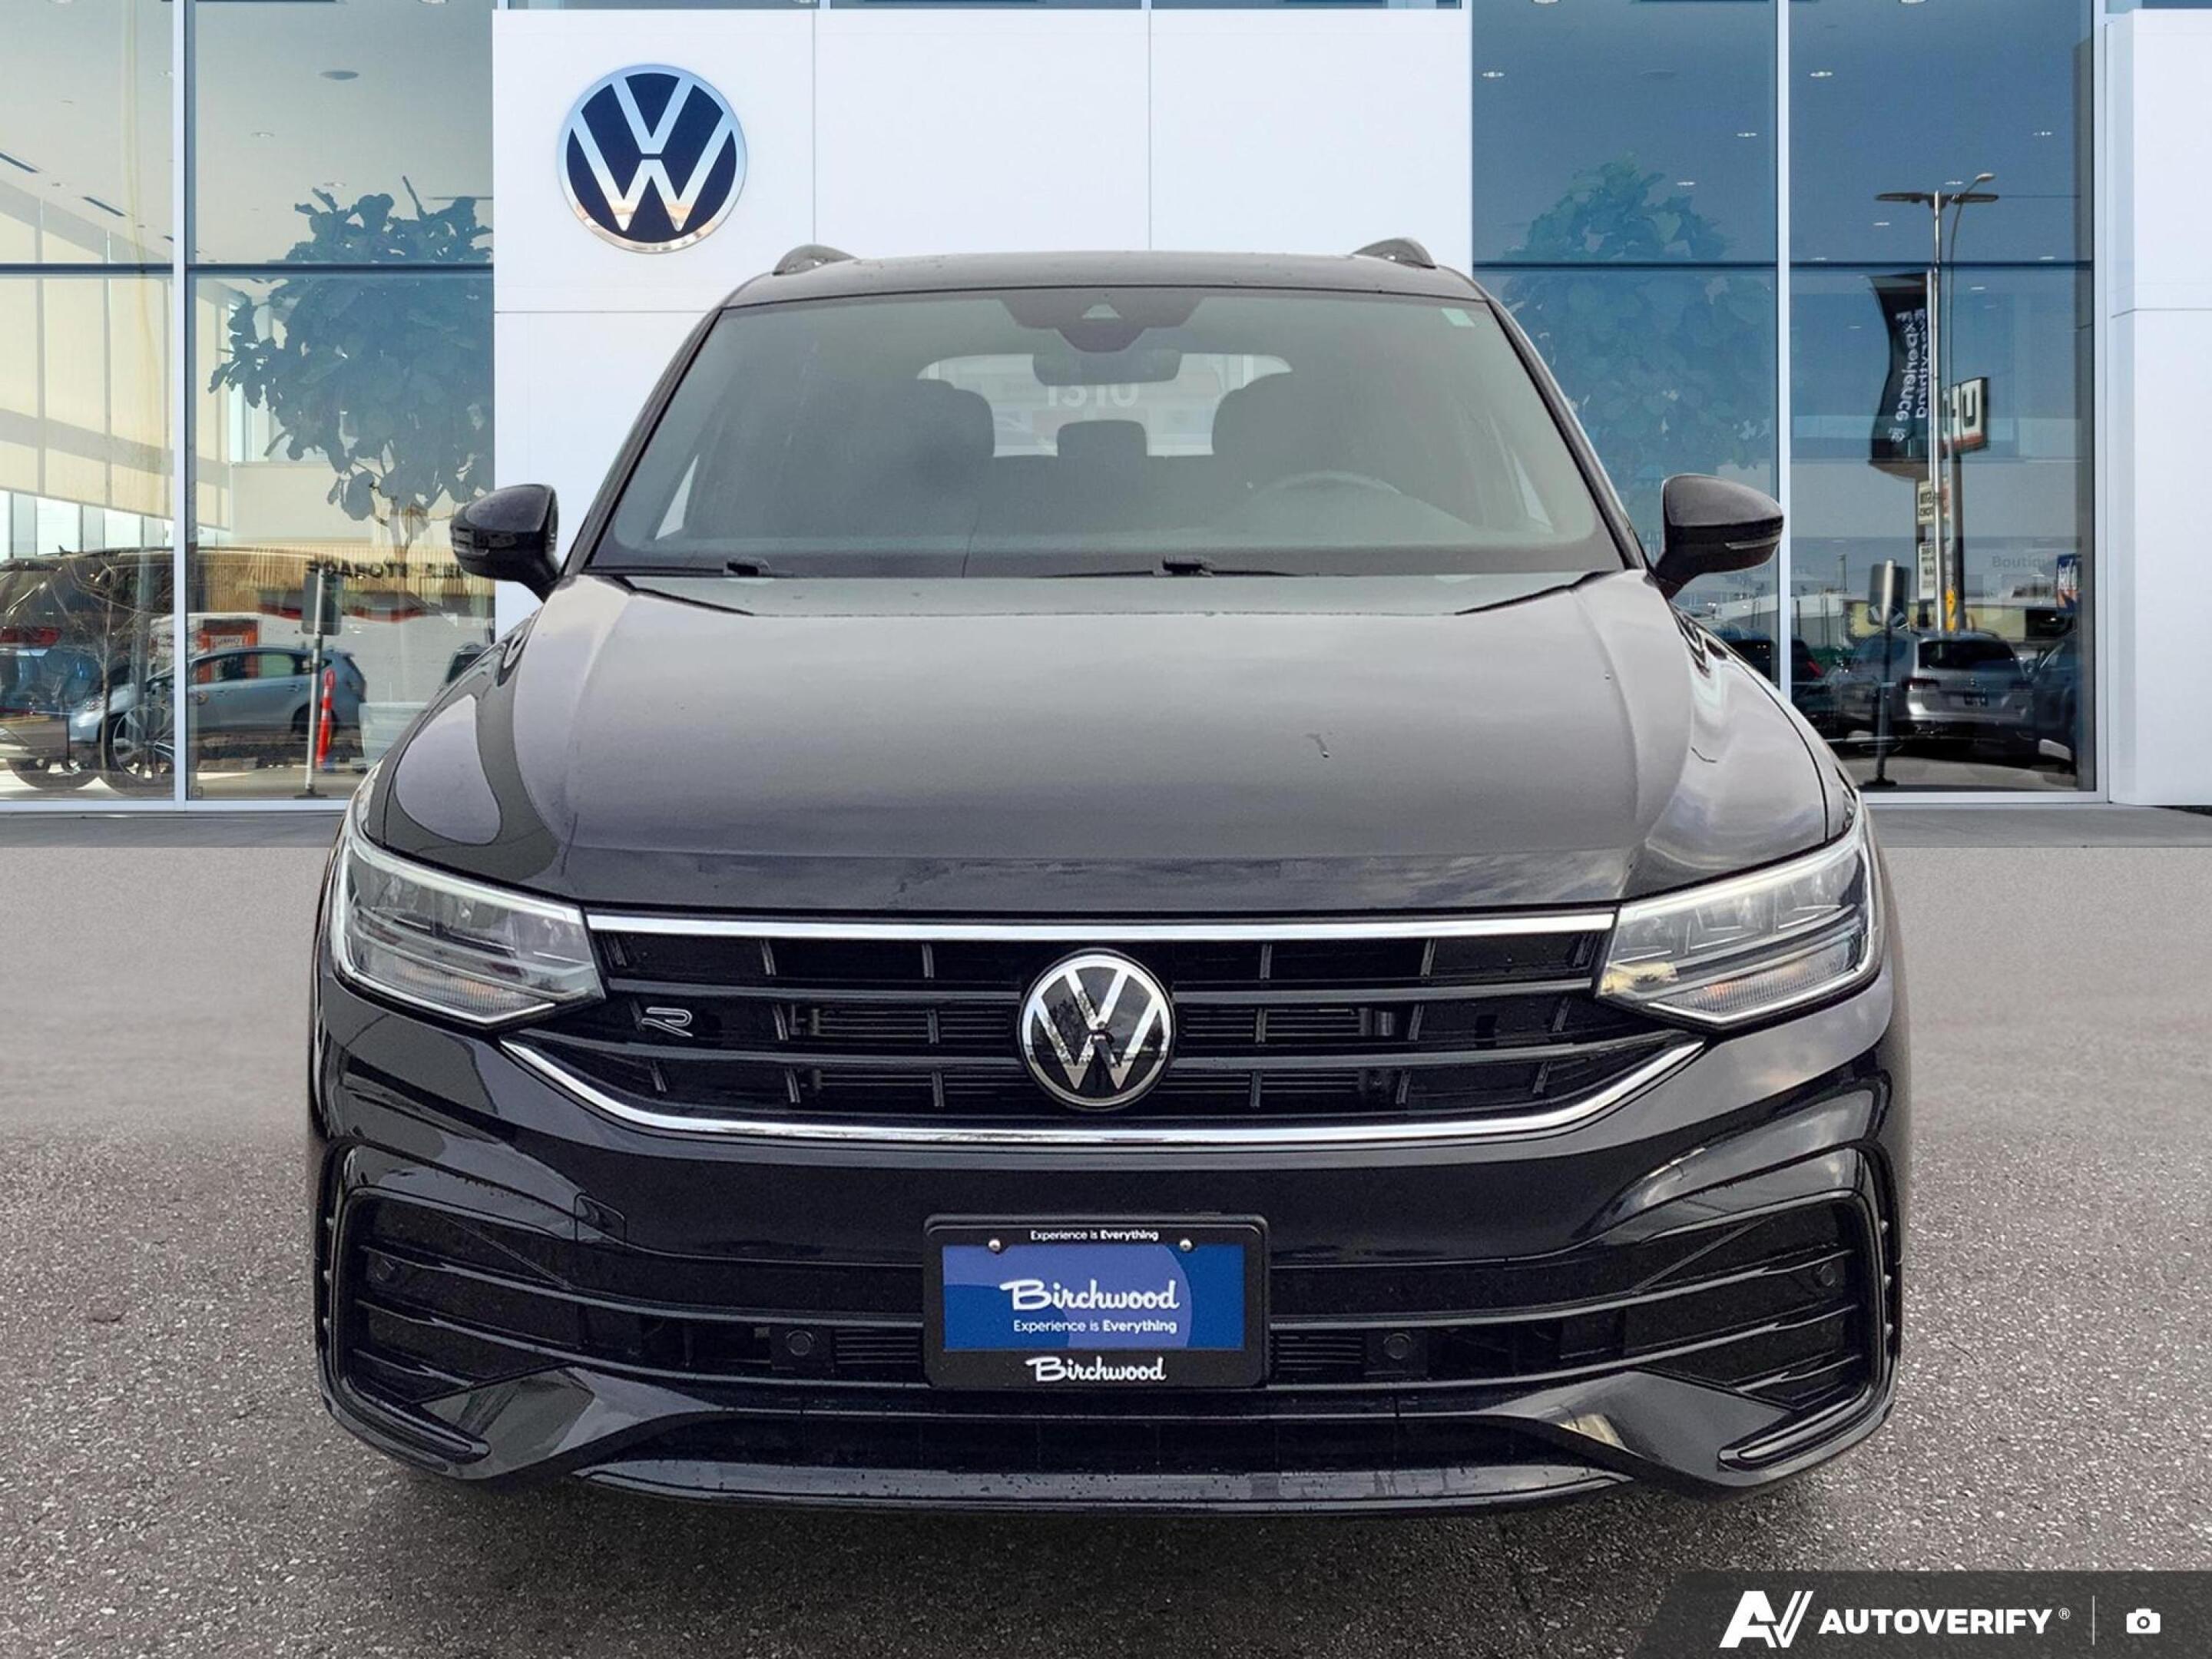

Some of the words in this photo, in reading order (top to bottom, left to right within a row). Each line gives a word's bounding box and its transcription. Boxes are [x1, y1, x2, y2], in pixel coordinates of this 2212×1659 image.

[1030, 1230, 1088, 1242] Experience
[1090, 1230, 1098, 1240] is
[1100, 1229, 1160, 1242] Everything
[999, 1278, 1181, 1310] Birchwood
[1013, 1320, 1086, 1333] Experience
[1089, 1320, 1100, 1333] is
[1103, 1320, 1177, 1334] Everything
[1025, 1356, 1167, 1382] Birchwood
